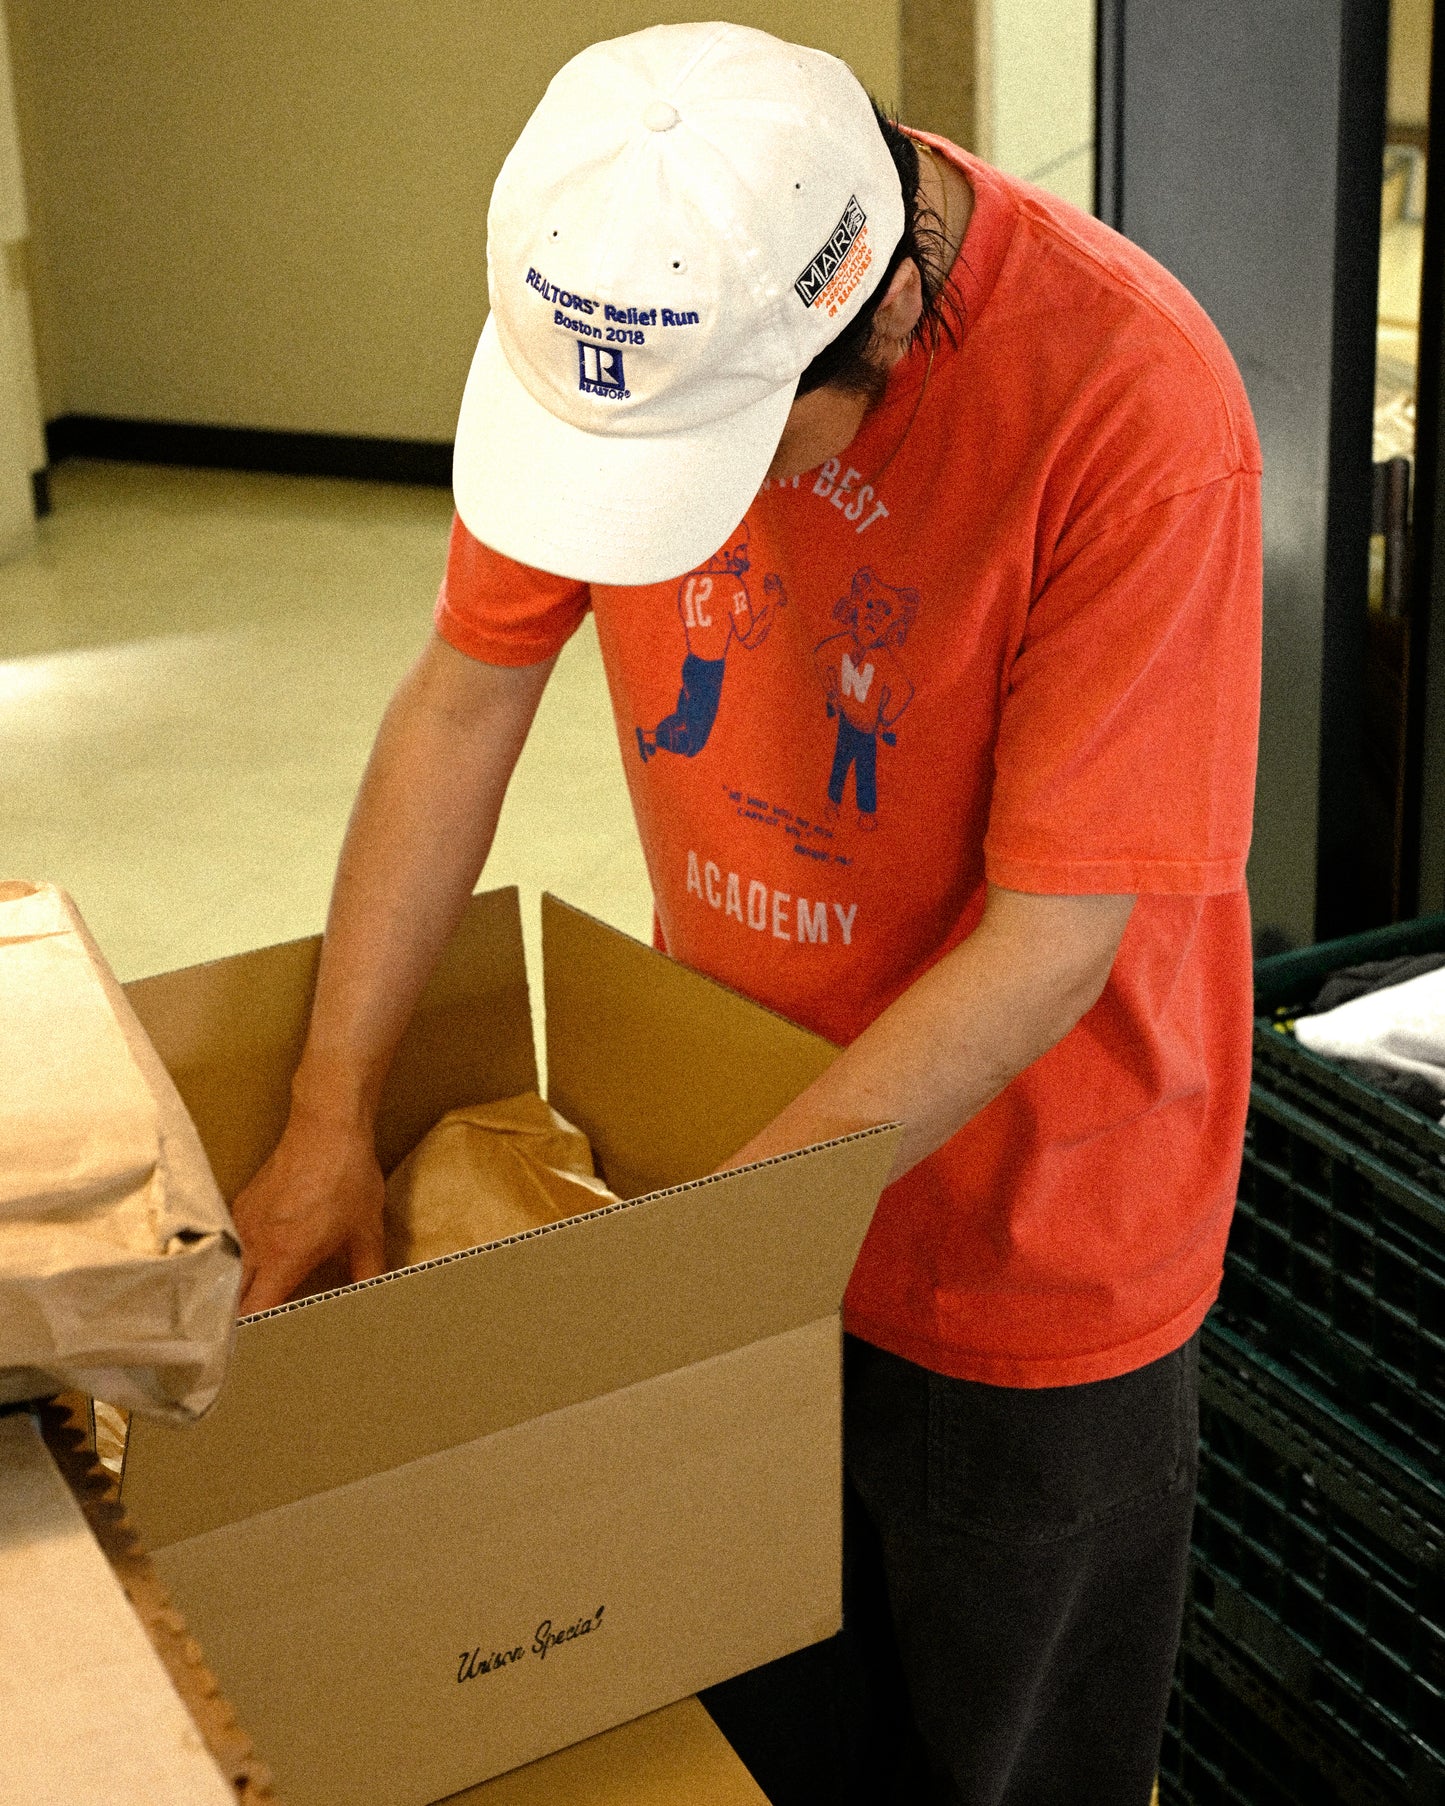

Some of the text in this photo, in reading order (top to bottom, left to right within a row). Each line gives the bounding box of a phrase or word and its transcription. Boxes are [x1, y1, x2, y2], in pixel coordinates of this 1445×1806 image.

[826, 243, 867, 308] ASSOCIATION
[554, 310, 645, 345] Boston 2018
[604, 305, 657, 326] Relief
[661, 308, 700, 327] Run
[812, 457, 890, 534] BEST
[686, 577, 713, 627] 12
[841, 653, 874, 703] N
[687, 850, 858, 945] ACADEMY
